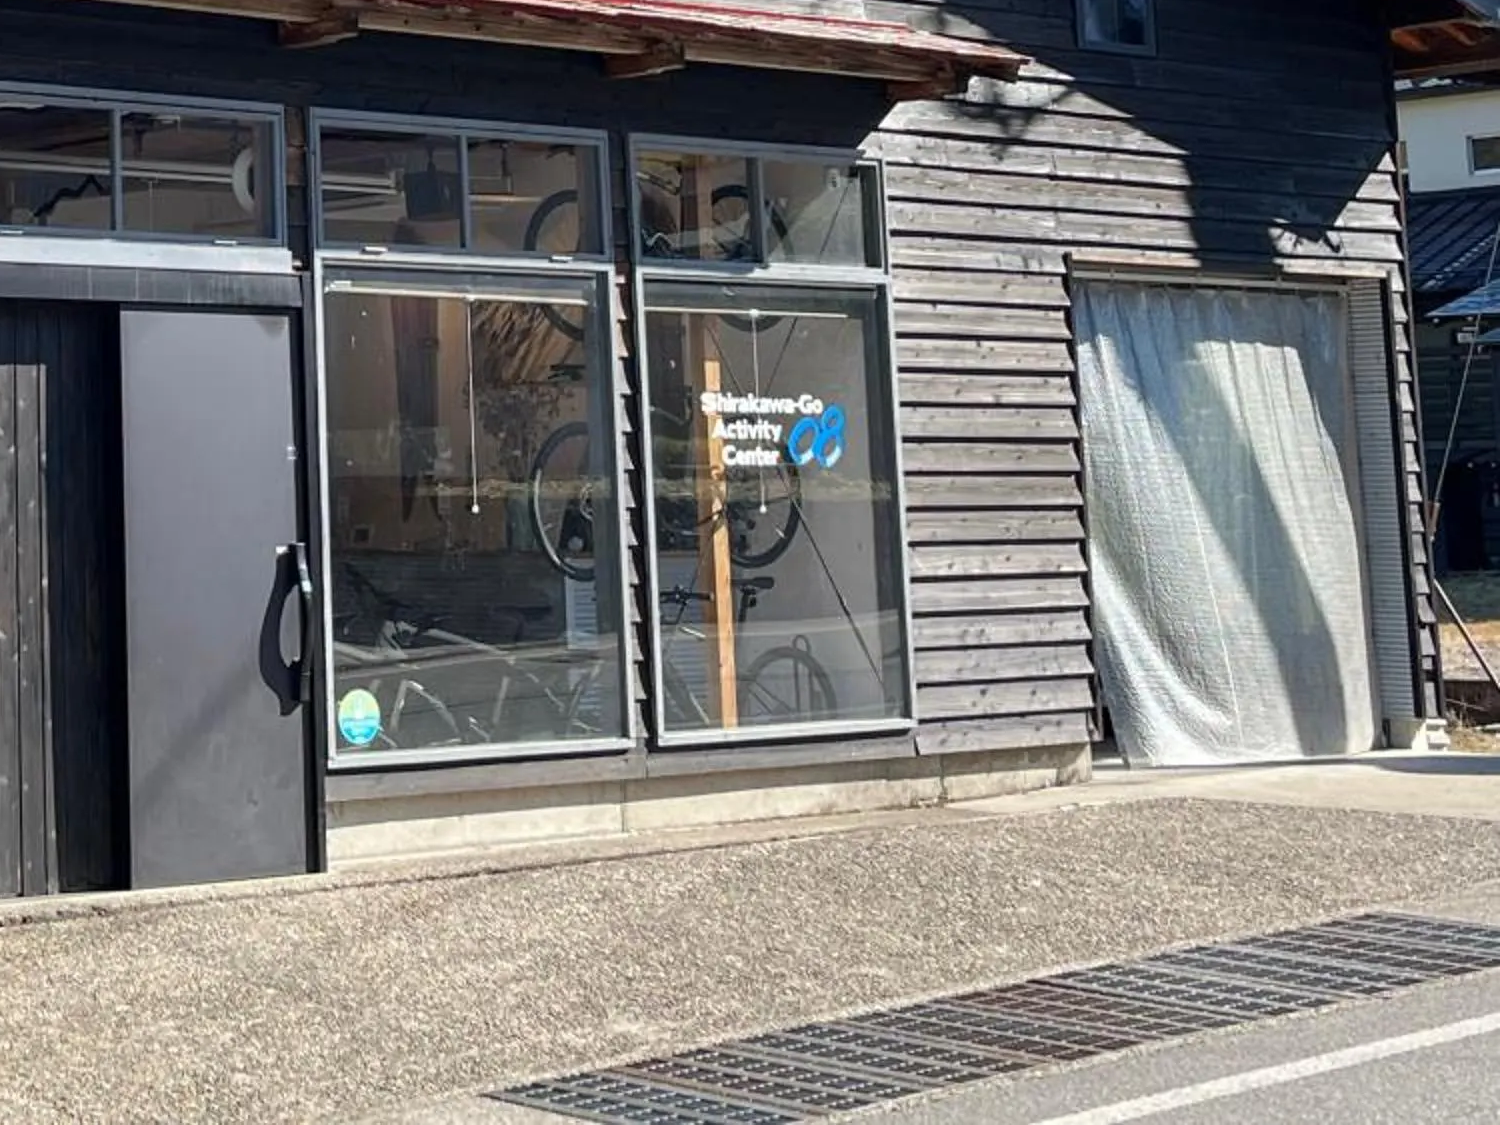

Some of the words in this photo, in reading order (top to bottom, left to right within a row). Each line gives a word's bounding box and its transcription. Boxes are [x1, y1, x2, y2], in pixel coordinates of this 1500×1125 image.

[700, 392, 823, 414] Shirakawa-Go
[712, 417, 783, 442] Activity
[722, 444, 780, 466] Center
